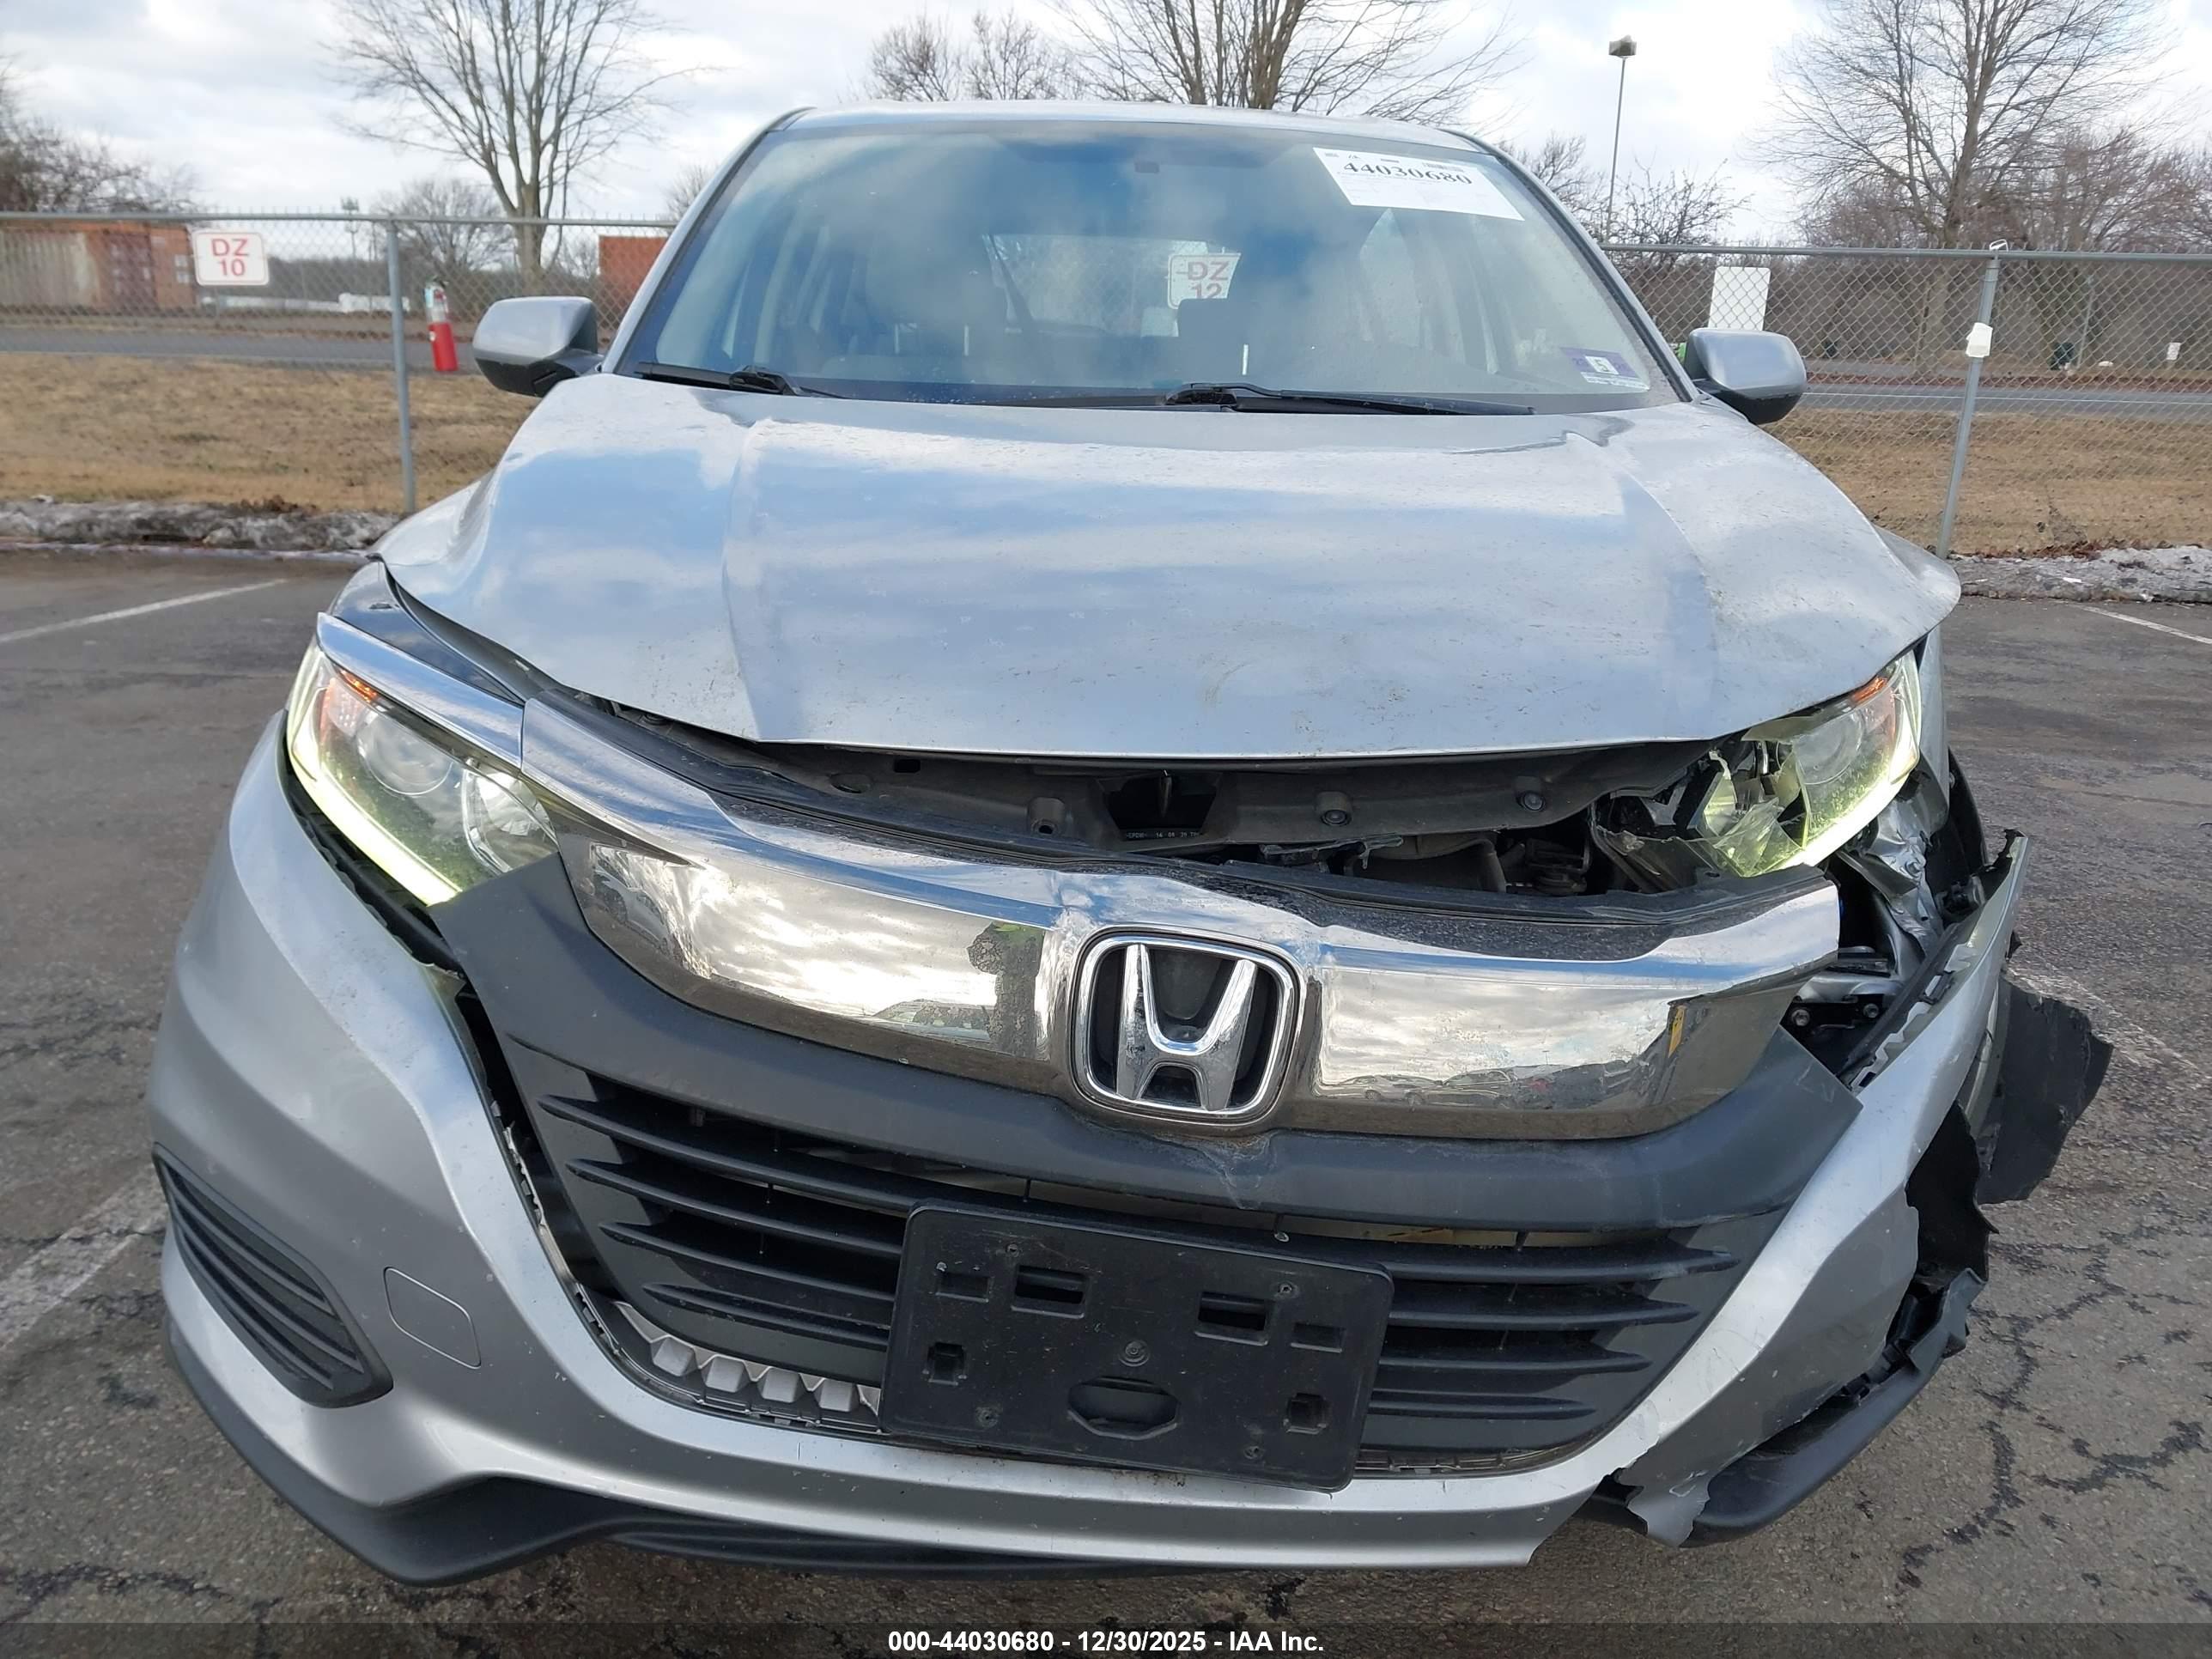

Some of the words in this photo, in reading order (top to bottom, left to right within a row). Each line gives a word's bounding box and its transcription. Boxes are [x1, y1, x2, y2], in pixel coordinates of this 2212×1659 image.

[1344, 161, 1473, 185] 44030680
[210, 238, 250, 256] DZ
[216, 258, 246, 276] 10
[1187, 261, 1230, 281] DZ
[1189, 283, 1222, 300] 12
